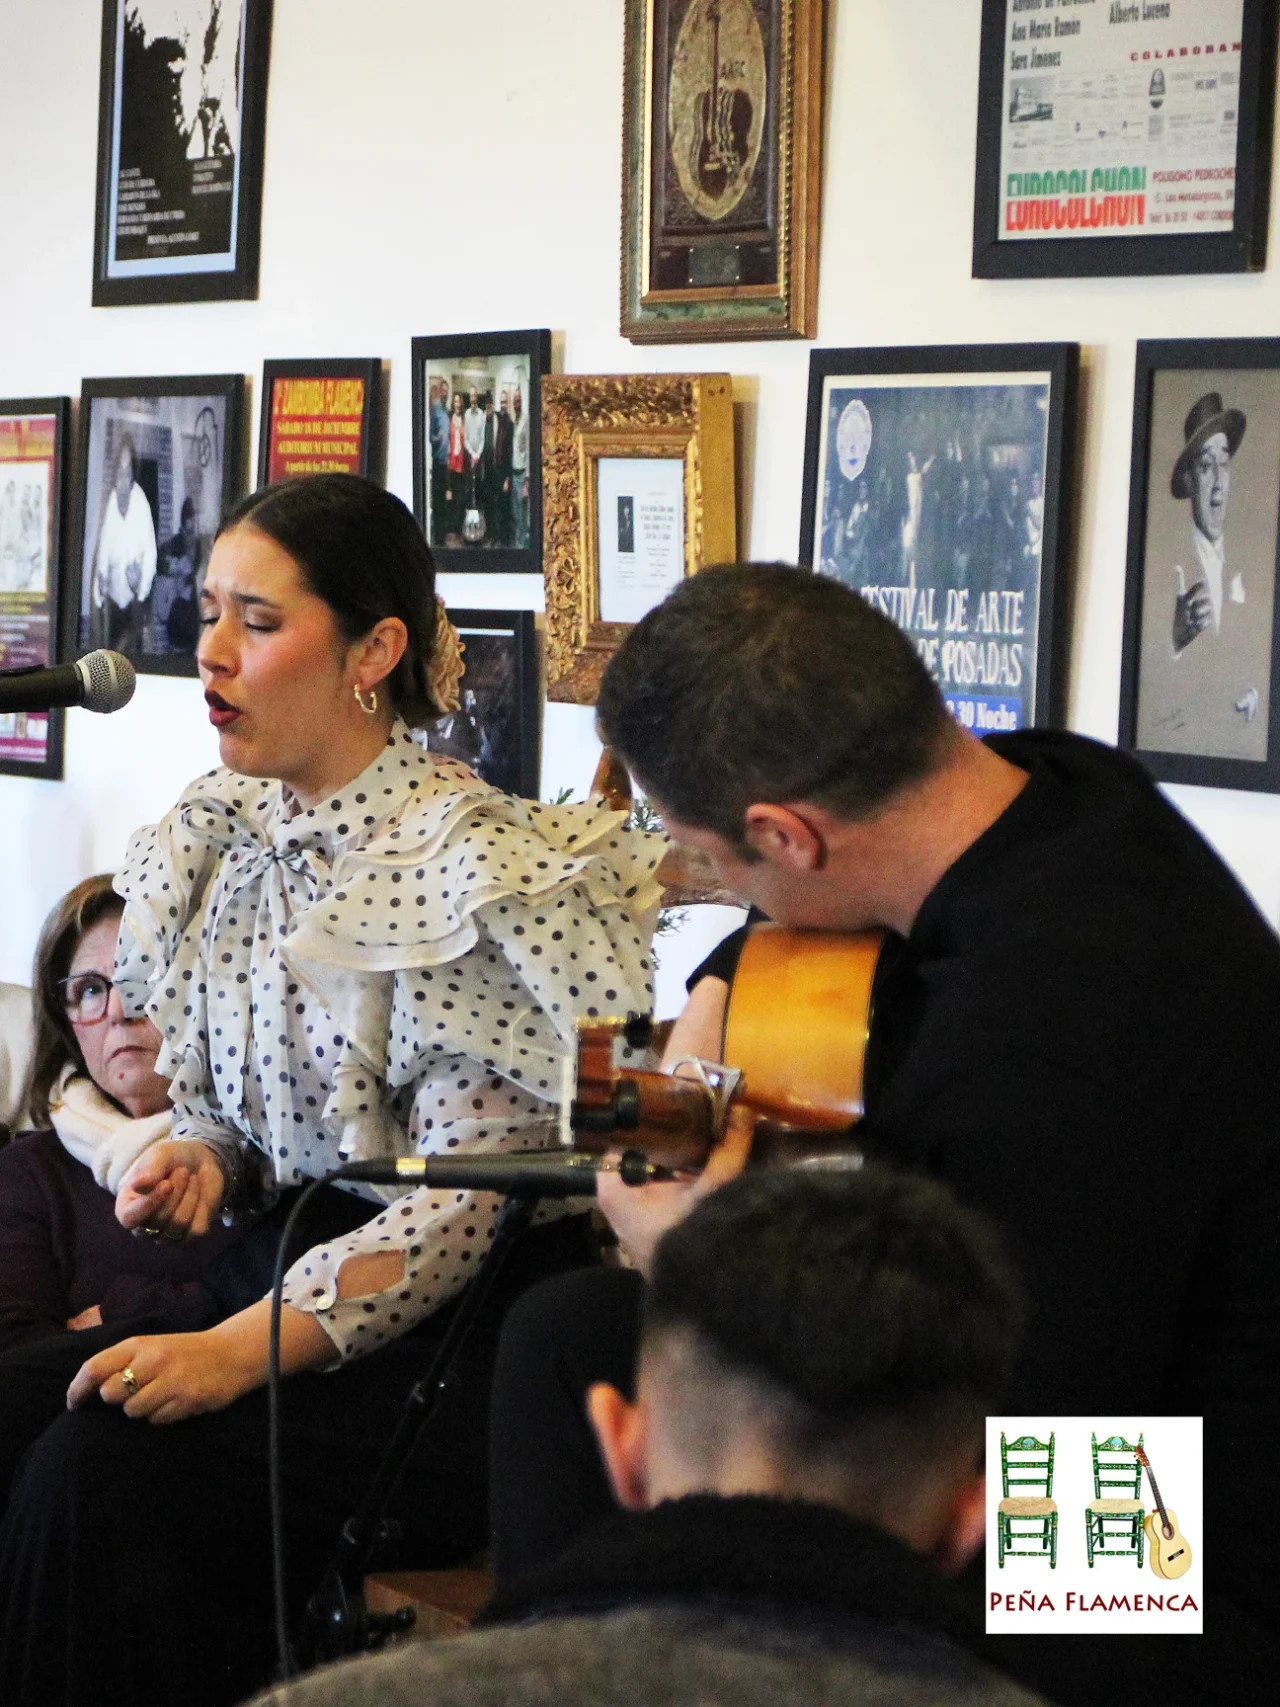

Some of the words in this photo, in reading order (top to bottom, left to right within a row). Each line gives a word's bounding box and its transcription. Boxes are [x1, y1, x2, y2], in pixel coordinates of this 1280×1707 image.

[1109, 2, 1140, 24] Alberto
[1142, 2, 1170, 21] Lucena
[1130, 42, 1242, 62] COLABORAN
[945, 588, 969, 632] DE
[974, 590, 1024, 635] ARTE
[941, 639, 1023, 688] POSADAS
[976, 702, 1017, 731] Noche
